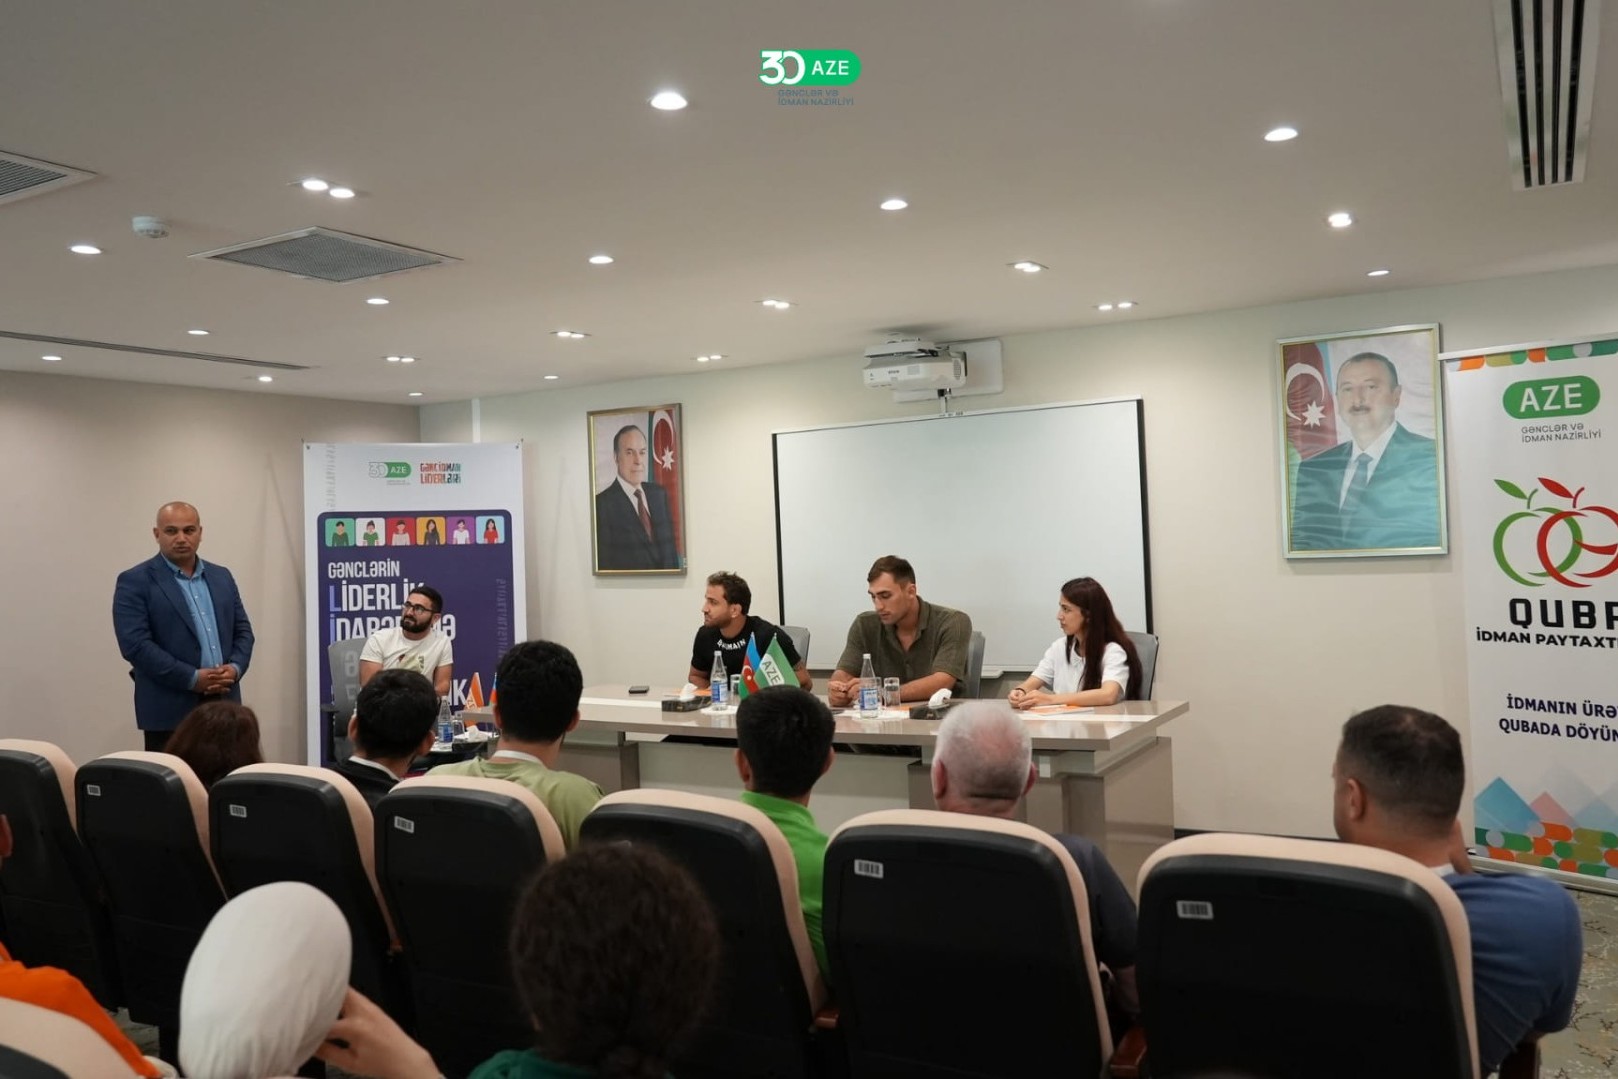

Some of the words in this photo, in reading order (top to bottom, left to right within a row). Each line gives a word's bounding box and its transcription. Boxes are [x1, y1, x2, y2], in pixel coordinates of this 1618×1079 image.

[1520, 383, 1582, 412] AZE
[1521, 424, 1568, 434] GƏNCLƏR
[1570, 423, 1584, 431] VƏ
[1521, 434, 1553, 443] İDMAN
[1555, 428, 1601, 440] NAZİRLİYİ
[328, 559, 400, 578] GƏNCLƏRİN
[329, 578, 425, 612] LİDERLİ
[1476, 626, 1531, 644] İDMAN
[1535, 633, 1618, 649] PAYTAXT
[762, 661, 780, 686] AZE
[1507, 693, 1577, 715] İDMANIN
[1582, 700, 1618, 718] ÜRƏ
[1499, 718, 1561, 737] QUBADA
